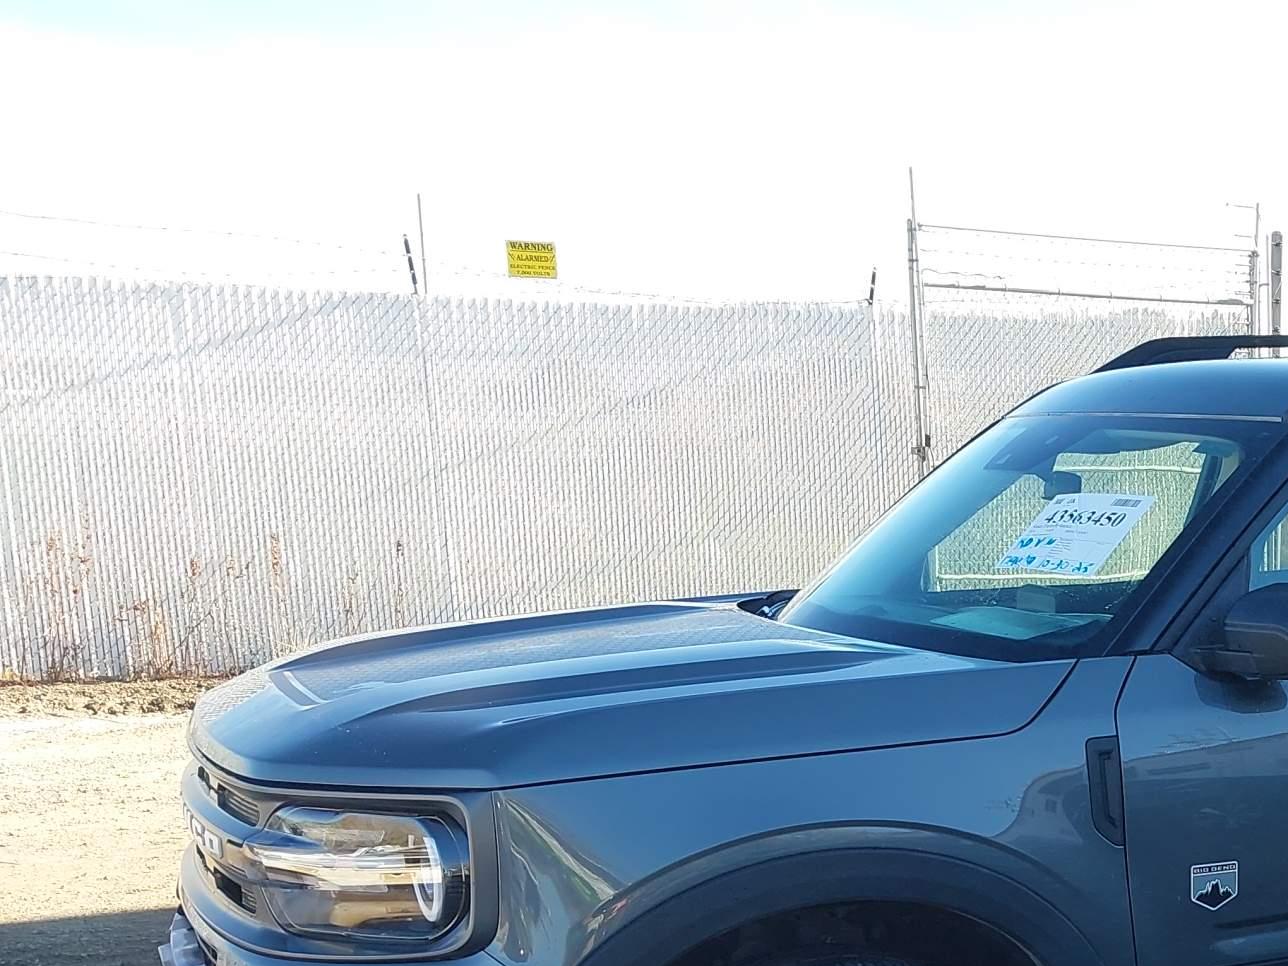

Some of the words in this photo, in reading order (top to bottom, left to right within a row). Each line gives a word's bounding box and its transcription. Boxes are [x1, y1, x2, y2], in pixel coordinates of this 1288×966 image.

[509, 241, 553, 252] WARNING
[516, 254, 549, 263] ALARMED
[1045, 509, 1127, 528] 43563450
